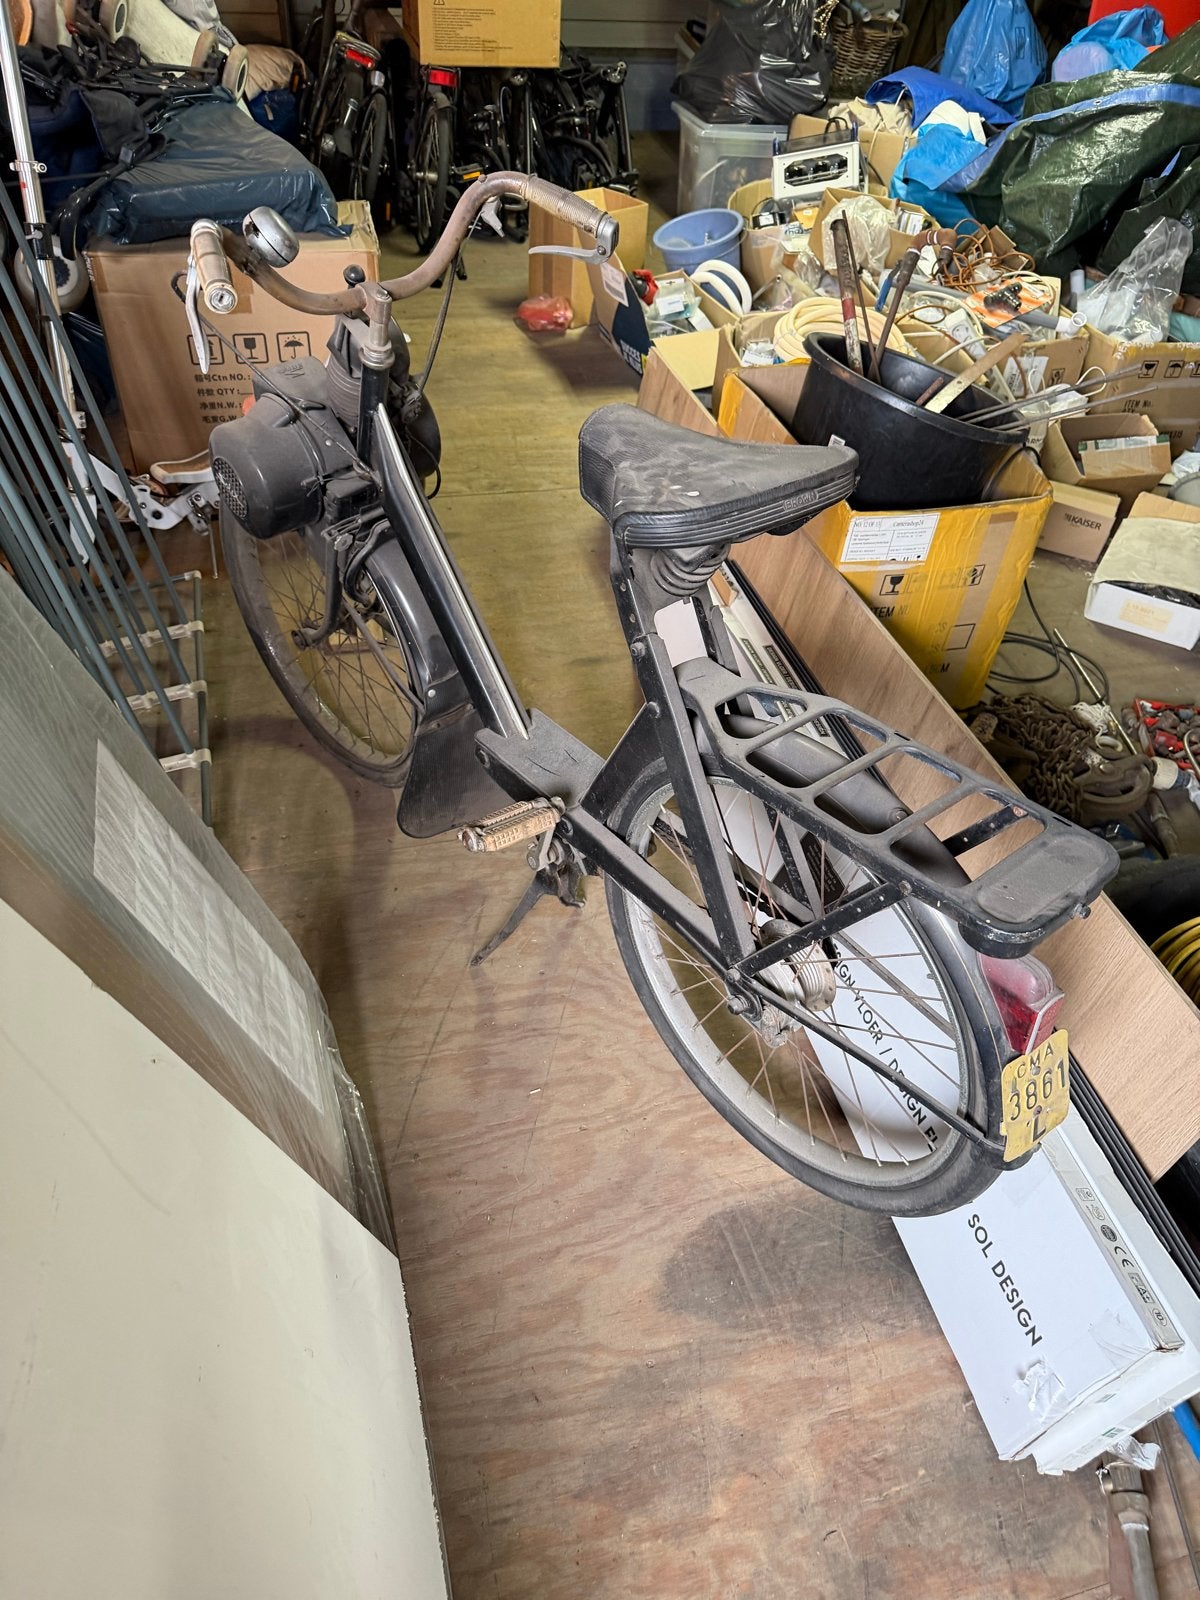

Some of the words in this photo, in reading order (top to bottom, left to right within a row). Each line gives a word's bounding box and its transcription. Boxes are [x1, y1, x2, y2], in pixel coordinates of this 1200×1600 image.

[1070, 514, 1102, 531] KAISER
[1017, 1041, 1055, 1079] CMA
[1009, 1057, 1065, 1121] 3861
[1032, 1115, 1047, 1142] L
[967, 1213, 994, 1259] SOL
[991, 1259, 1043, 1347] DESIGN
